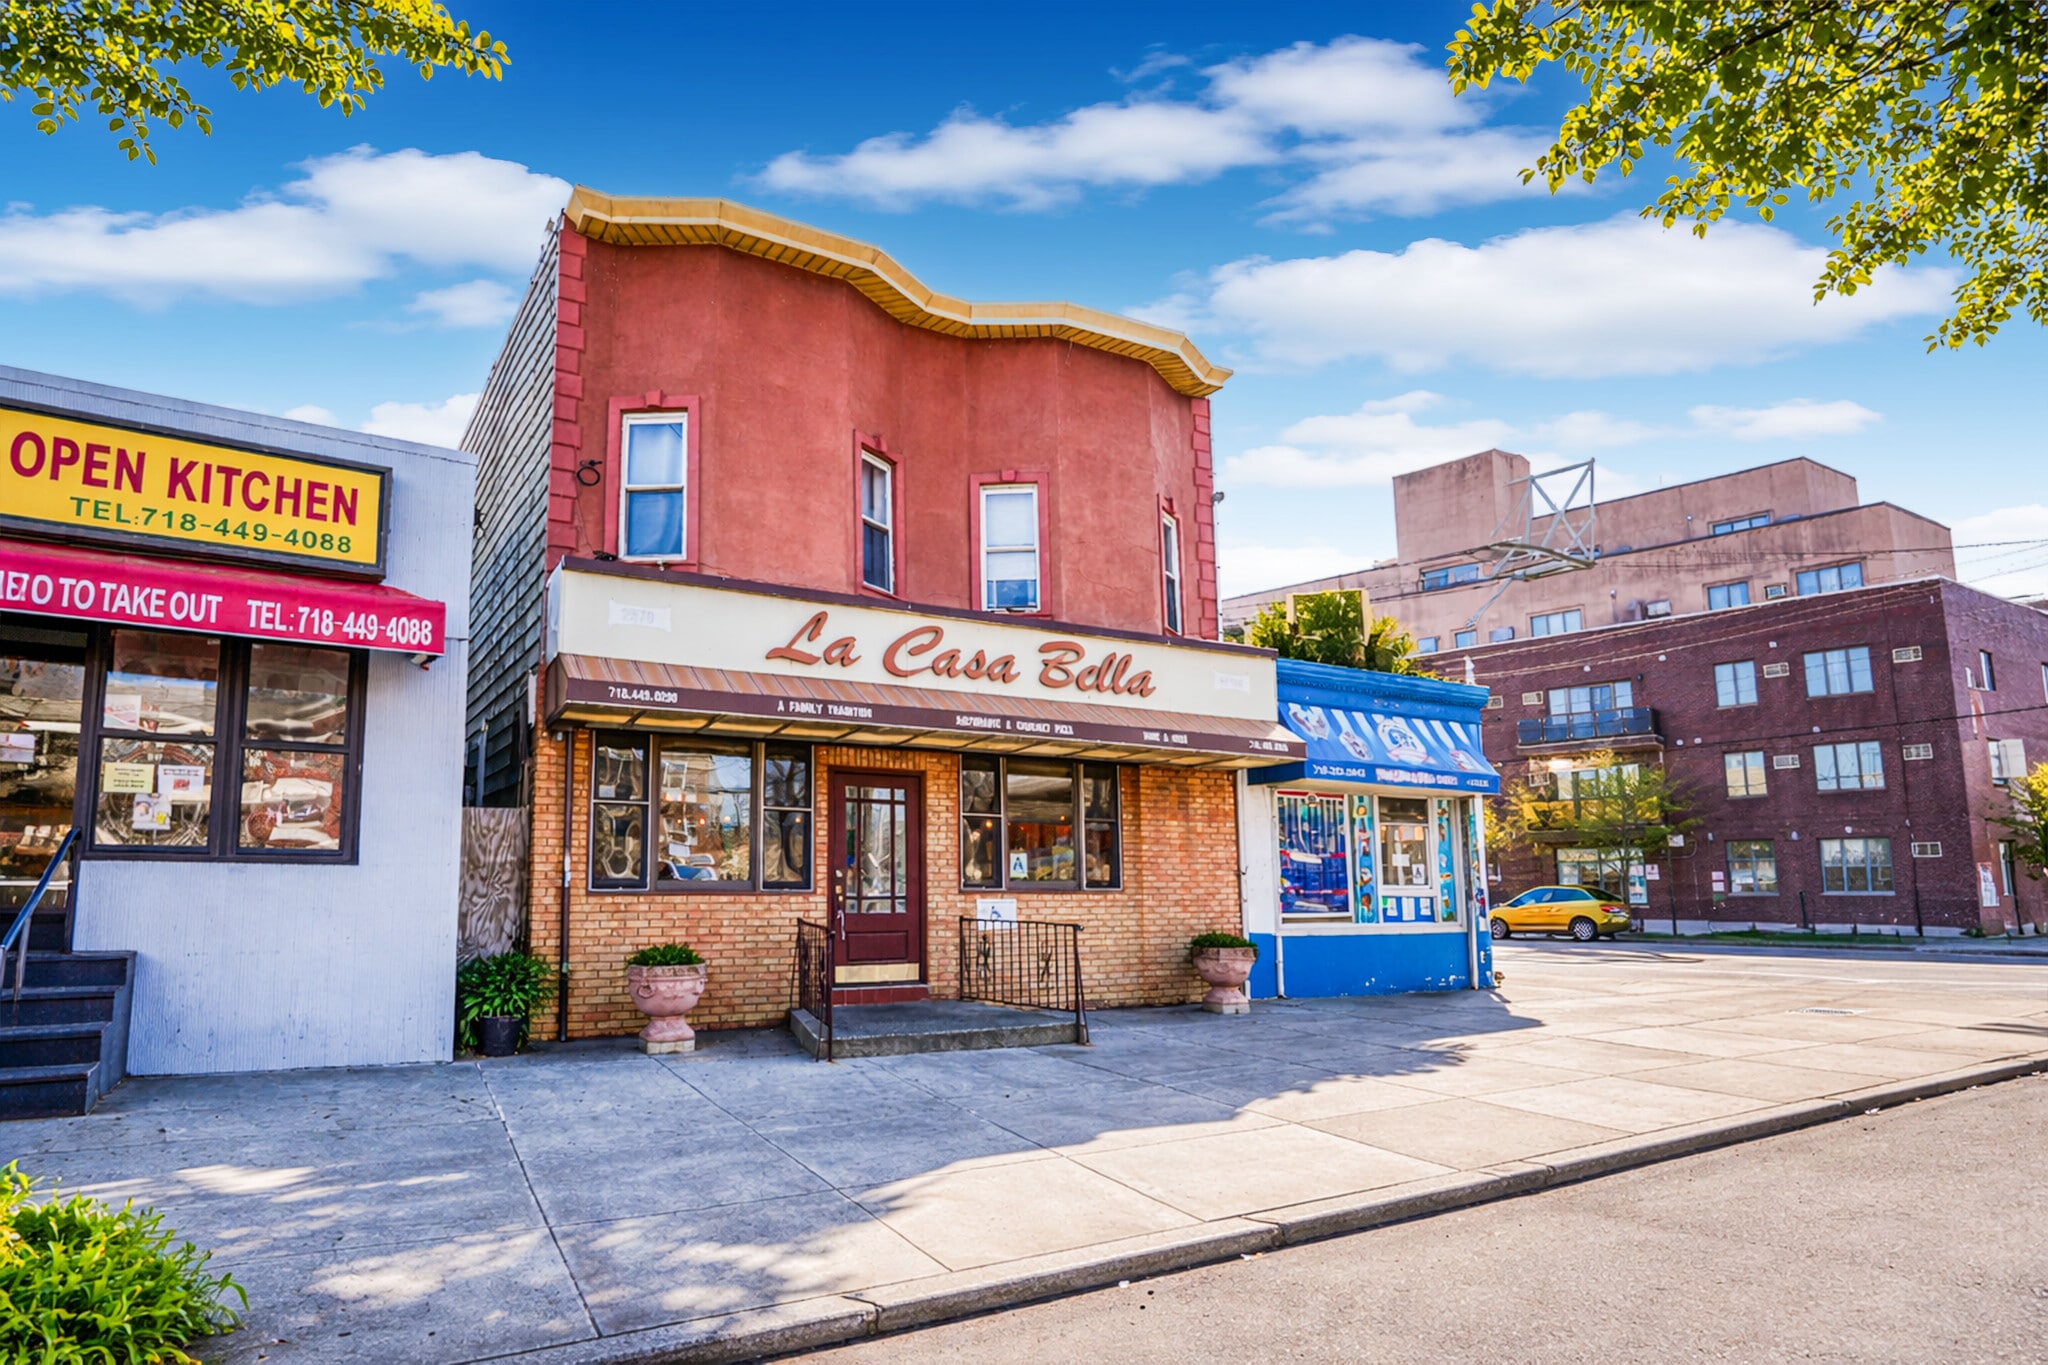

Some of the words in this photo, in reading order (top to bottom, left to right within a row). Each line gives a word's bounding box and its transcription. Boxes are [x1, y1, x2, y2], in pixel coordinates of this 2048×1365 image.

[10, 431, 146, 494] OPEN
[167, 457, 359, 526] KITCHEN
[70, 496, 352, 553] TEL:718-449-4088
[58, 577, 95, 610] TO
[100, 582, 166, 618] TAKE
[170, 591, 223, 623] OUT
[247, 599, 433, 646] TEL:718-449-4088
[765, 611, 861, 667] La
[883, 625, 1020, 683] Casa
[1038, 641, 1156, 698] Bella
